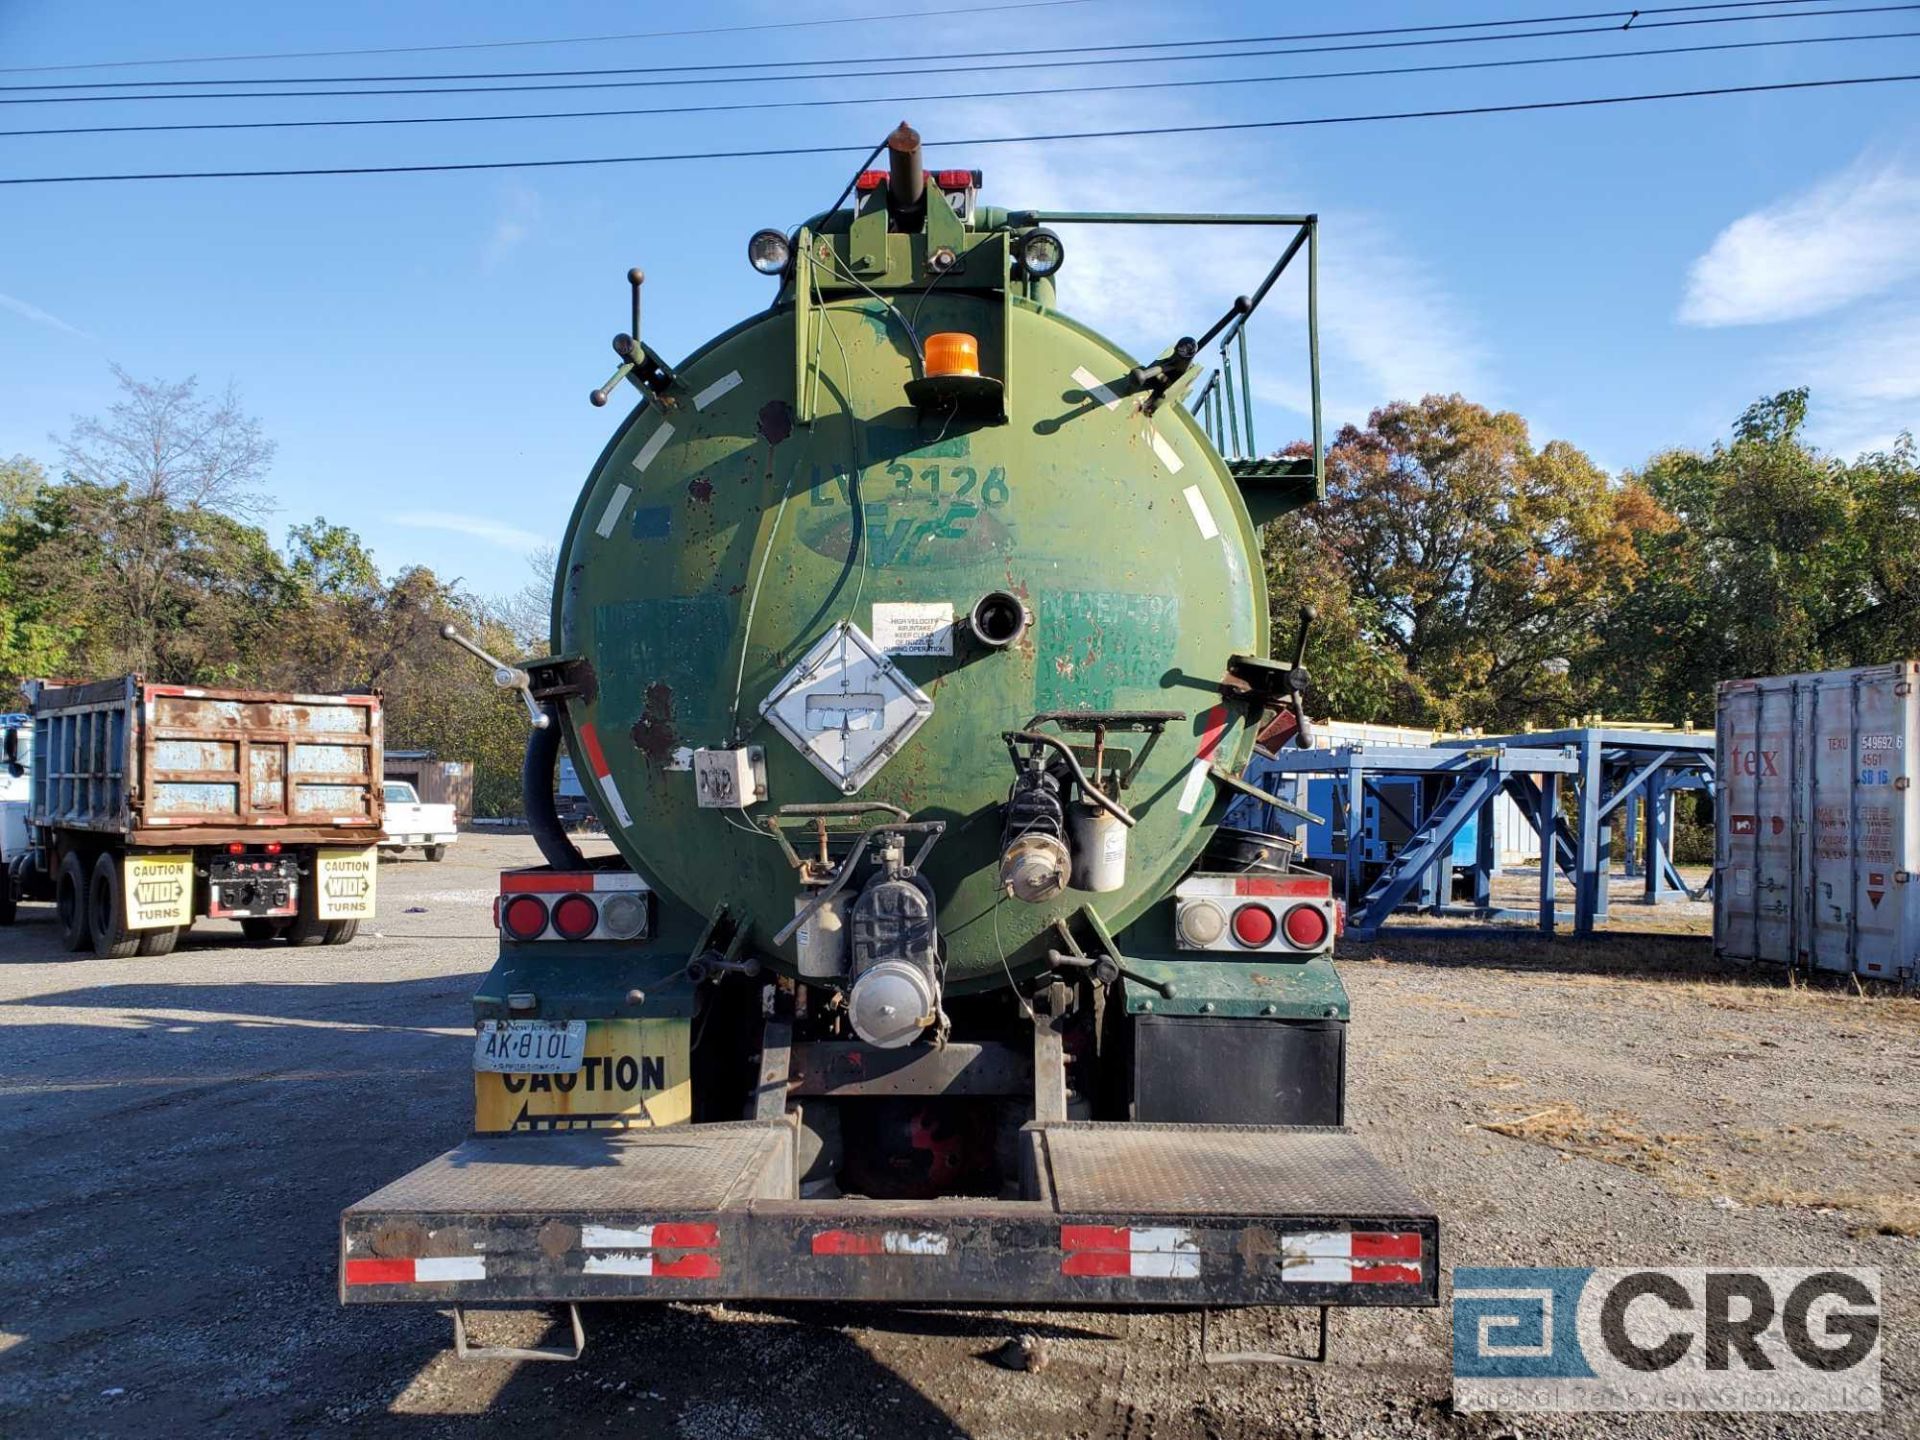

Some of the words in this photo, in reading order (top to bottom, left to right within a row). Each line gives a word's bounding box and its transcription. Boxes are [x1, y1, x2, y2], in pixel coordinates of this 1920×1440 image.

[885, 463, 1010, 507] 3126
[1828, 737, 1849, 750] TEXU
[1896, 735, 1904, 750] 6
[1731, 743, 1779, 777] tex
[133, 865, 184, 877] CAUTION
[325, 861, 370, 872] CAUTION
[137, 882, 181, 904] WIDE
[328, 878, 367, 896] WIDE
[138, 908, 180, 920] TURNS
[328, 902, 366, 912] TURNS
[503, 1056, 665, 1094] CAUTION
